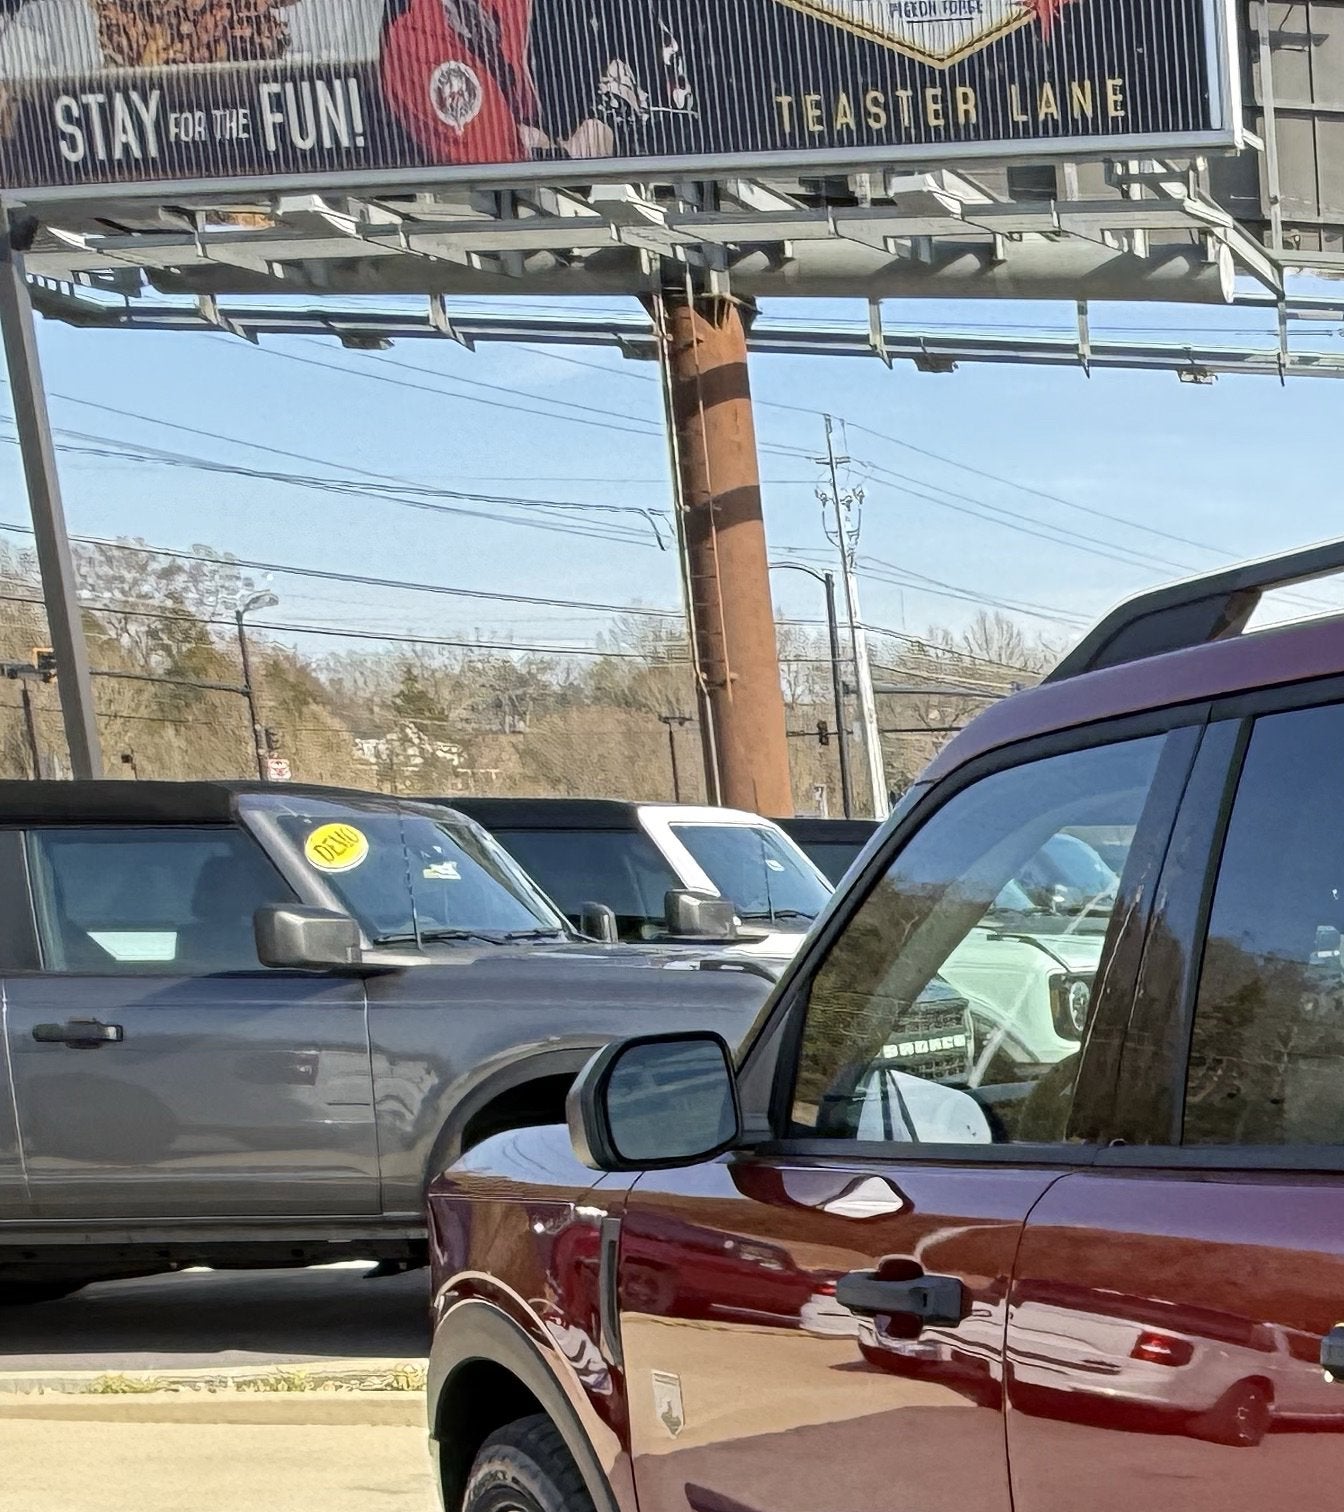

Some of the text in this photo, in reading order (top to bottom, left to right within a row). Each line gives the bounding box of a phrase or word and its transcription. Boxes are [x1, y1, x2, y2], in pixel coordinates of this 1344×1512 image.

[54, 77, 366, 164] STAY FOR THE FUN!
[775, 78, 1127, 135] TEASTER LANE
